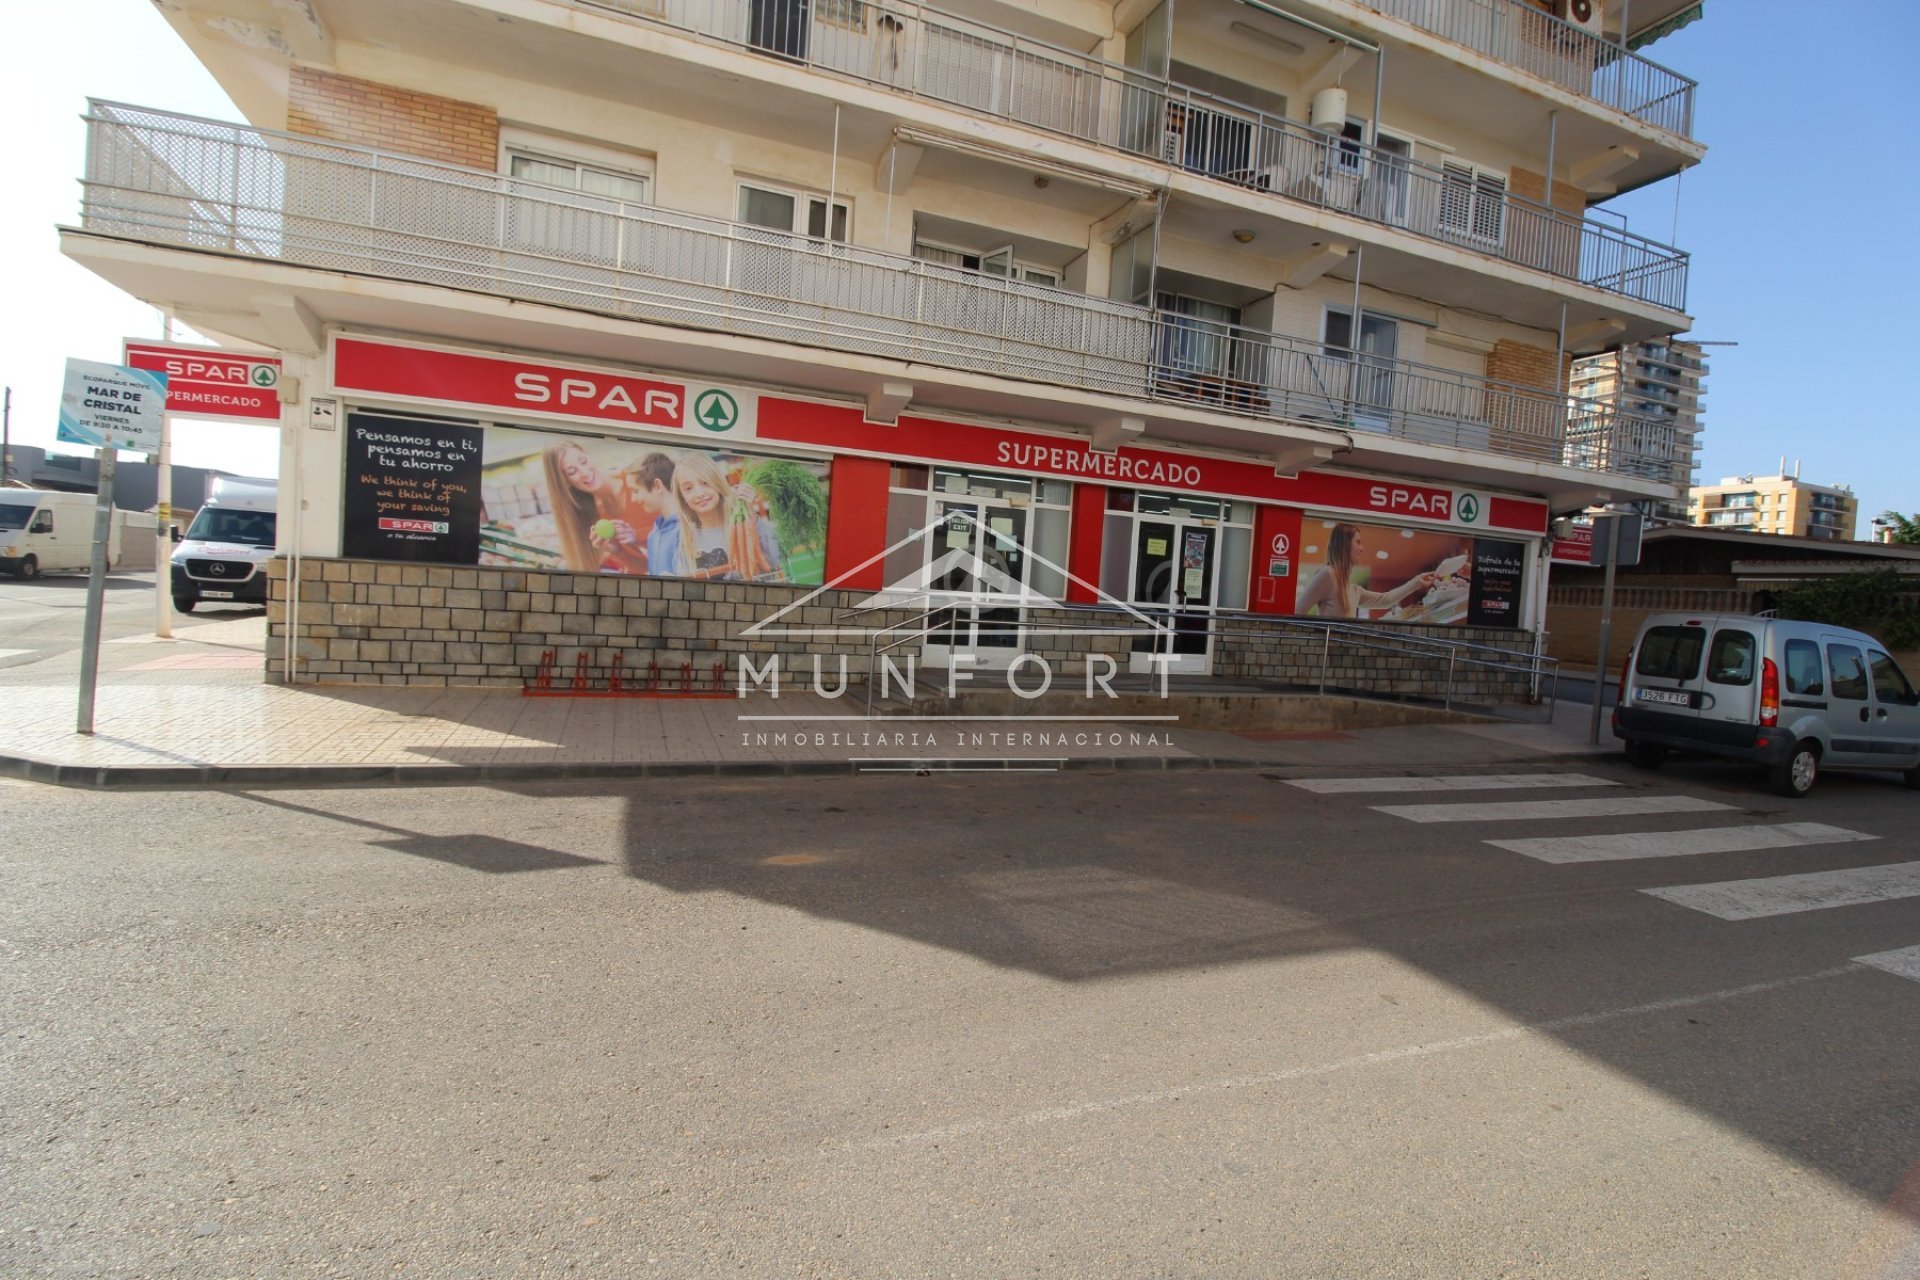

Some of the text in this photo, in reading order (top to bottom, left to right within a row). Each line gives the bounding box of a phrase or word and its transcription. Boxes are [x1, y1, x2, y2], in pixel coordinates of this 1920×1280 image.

[165, 361, 245, 381] SPAR
[83, 375, 128, 386] ECOPARQUE
[87, 386, 142, 402] MAR DE
[165, 390, 261, 407] PERMERCADO
[514, 372, 679, 419] SPAR
[83, 399, 142, 415] CRISTAL
[95, 414, 130, 424] VIERNES
[93, 421, 111, 429] 9:30
[121, 425, 143, 434] 10:45
[356, 428, 477, 453] Pensamos en ti,
[368, 444, 466, 462] pensamos en
[380, 454, 454, 472] tu ahorro
[997, 441, 1201, 486] SUPERMERCADO
[360, 474, 468, 495] We think of you,
[377, 488, 451, 503] we think of
[1370, 486, 1449, 515] SPAR
[377, 501, 450, 516] your saving
[391, 521, 434, 531] SPAR
[1643, 688, 1665, 701] 3526
